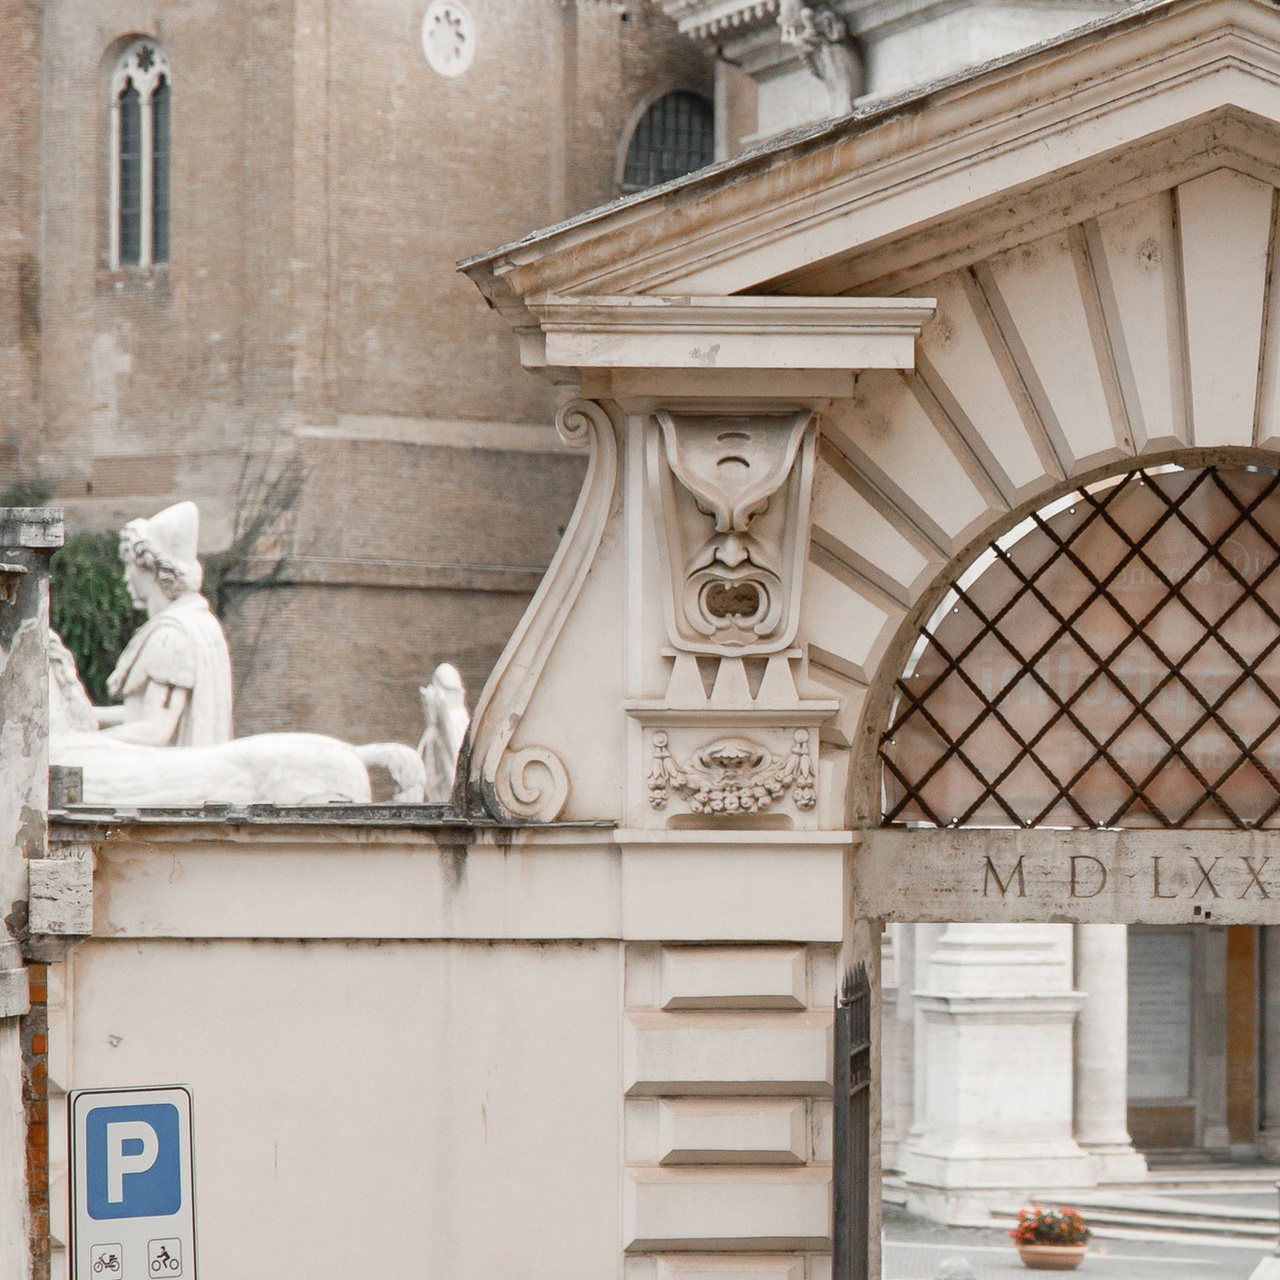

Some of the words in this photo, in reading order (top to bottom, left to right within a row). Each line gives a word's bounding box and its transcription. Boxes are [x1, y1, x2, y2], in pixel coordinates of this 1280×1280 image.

[981, 855, 1027, 899] M
[1068, 855, 1107, 899] D
[107, 1121, 159, 1203] P
